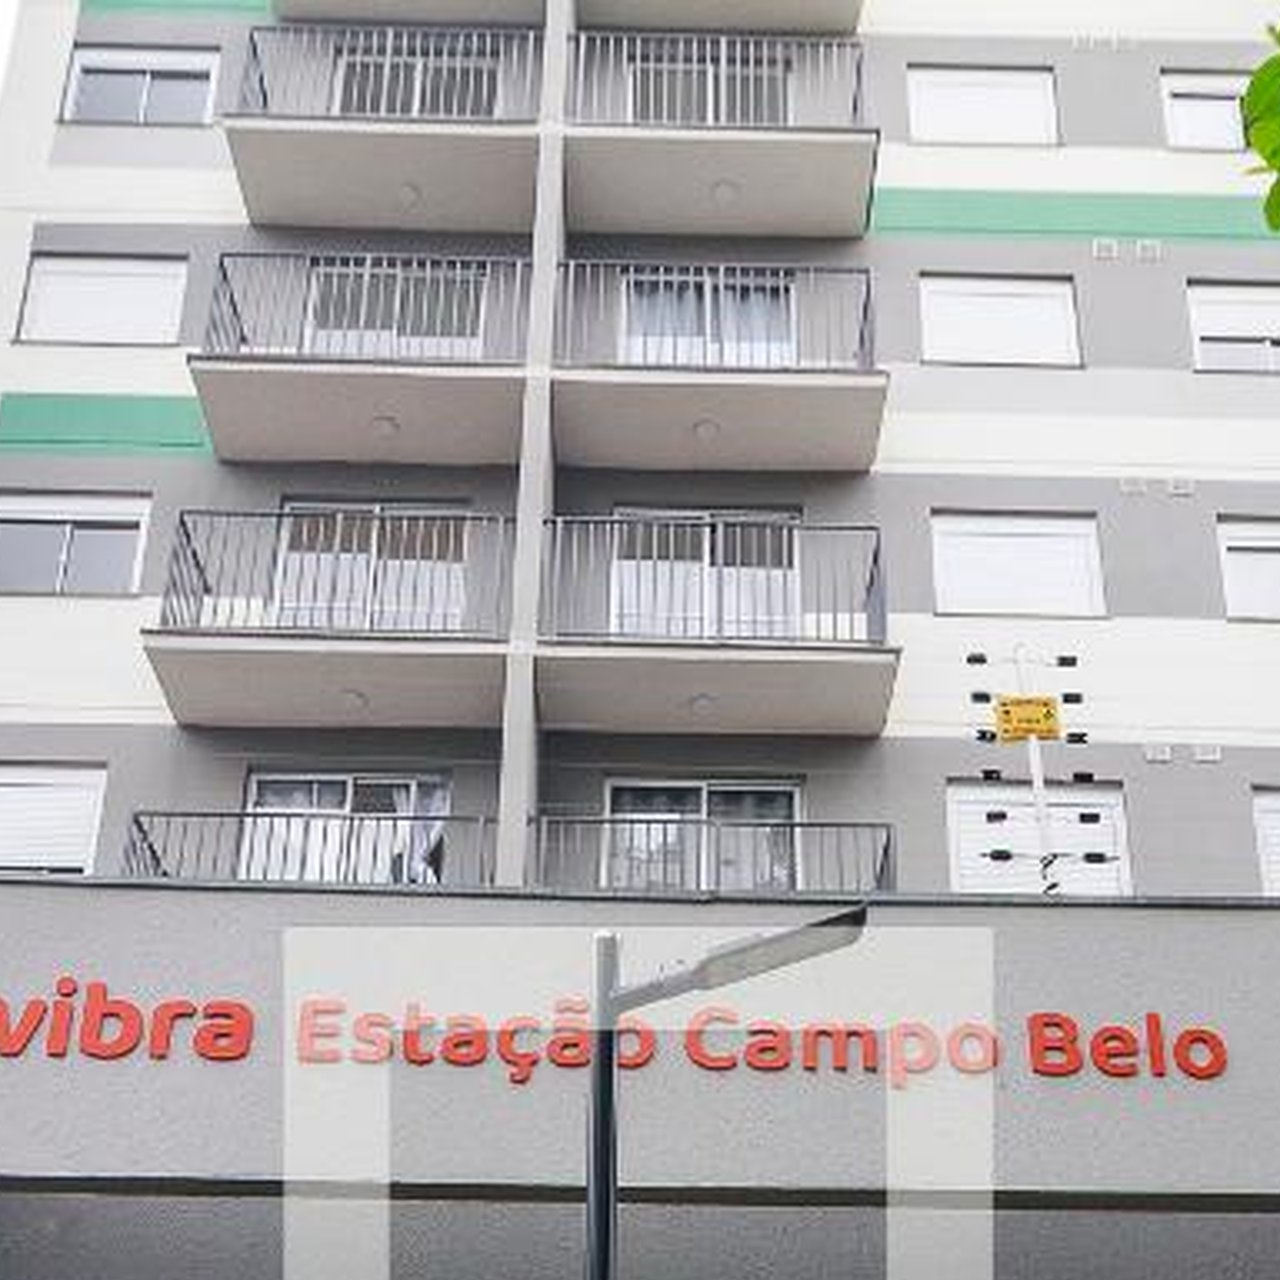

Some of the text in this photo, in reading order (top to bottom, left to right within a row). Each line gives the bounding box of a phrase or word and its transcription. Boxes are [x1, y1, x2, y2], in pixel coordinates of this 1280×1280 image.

[297, 992, 658, 1085] Estação
[683, 1006, 1000, 1090] Campo
[1026, 1012, 1229, 1081] Belo
